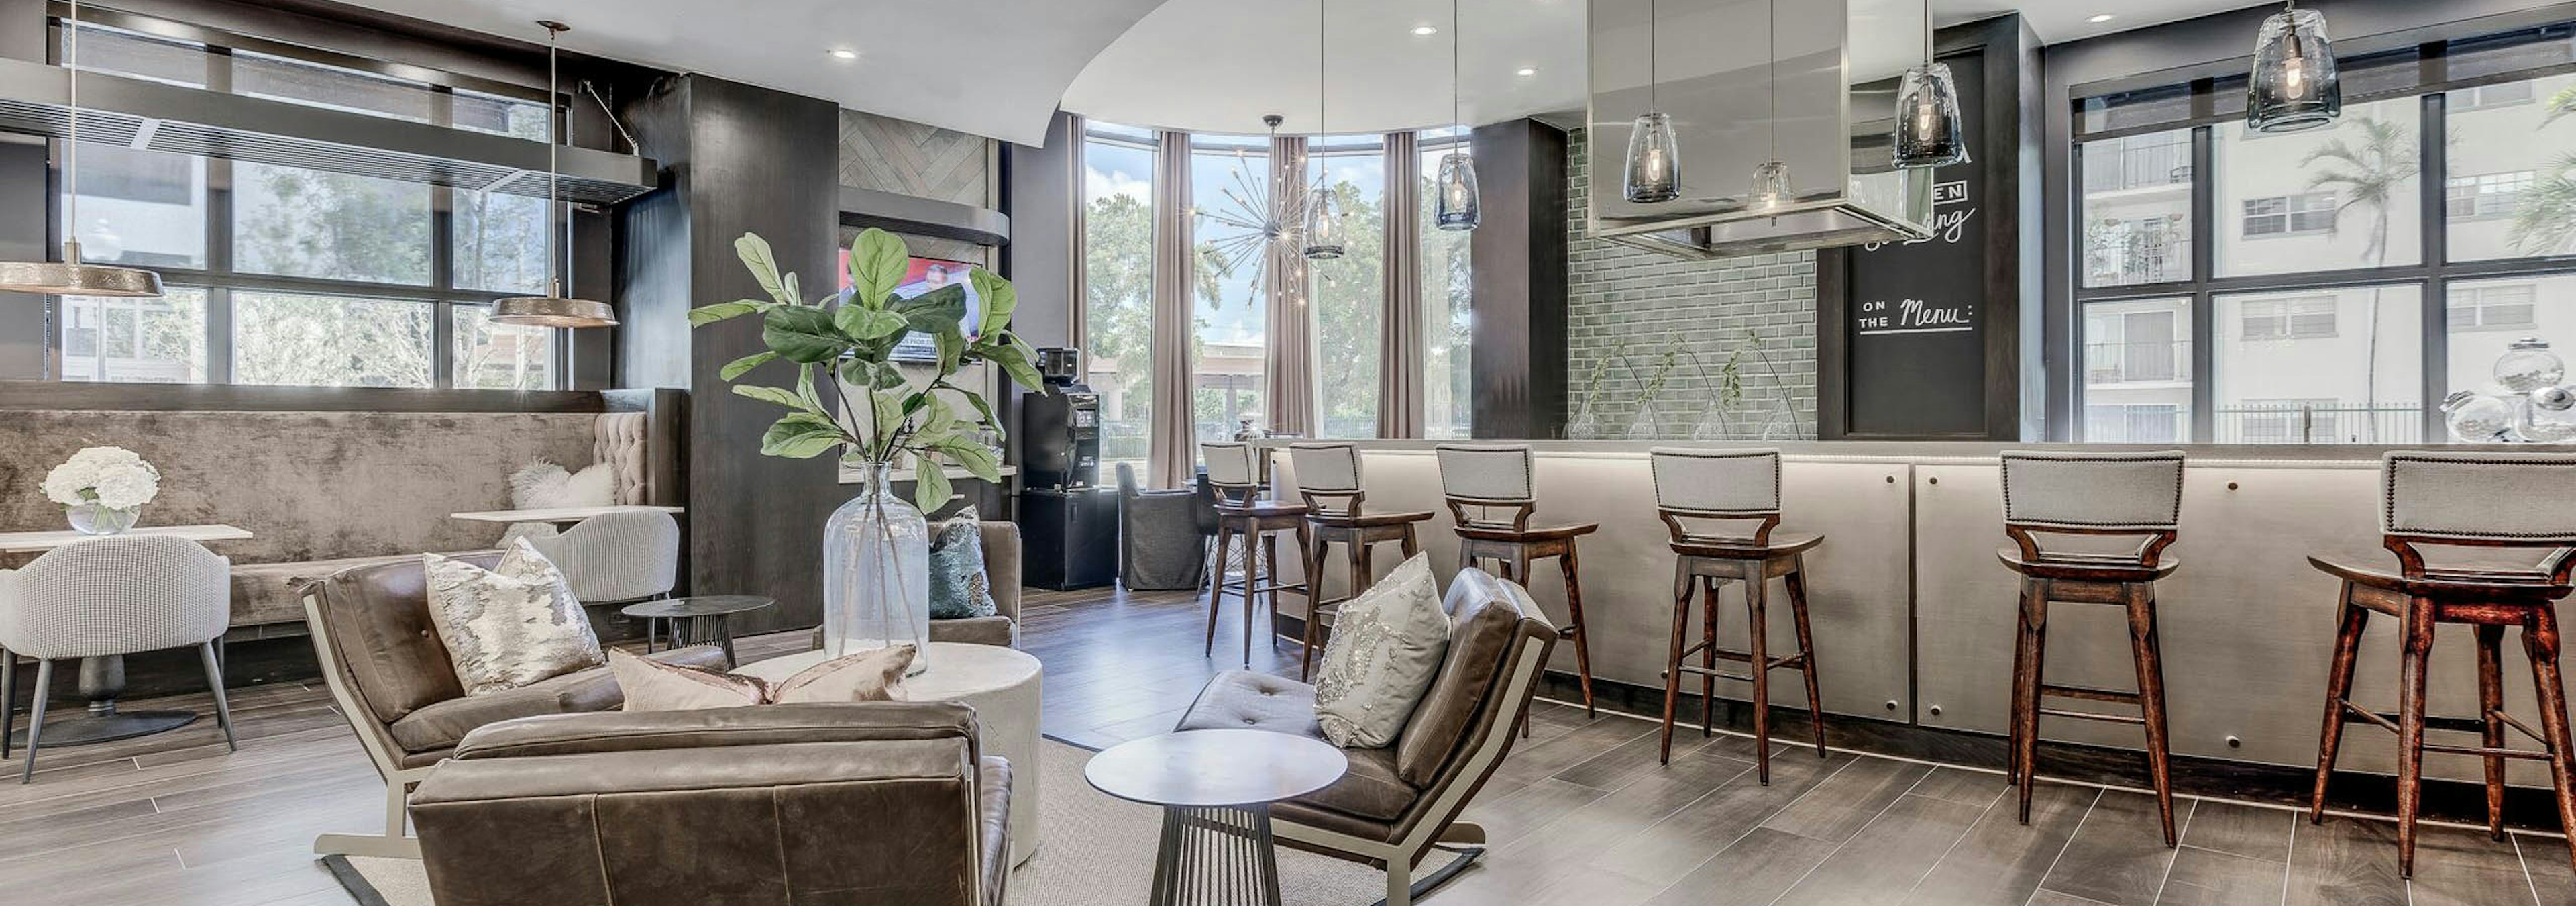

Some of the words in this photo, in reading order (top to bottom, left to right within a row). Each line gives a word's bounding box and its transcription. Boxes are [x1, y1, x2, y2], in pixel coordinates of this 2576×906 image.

[1858, 316, 1889, 328] THE
[1900, 298, 1973, 327] Menu:
[1862, 301, 1886, 312] ON
